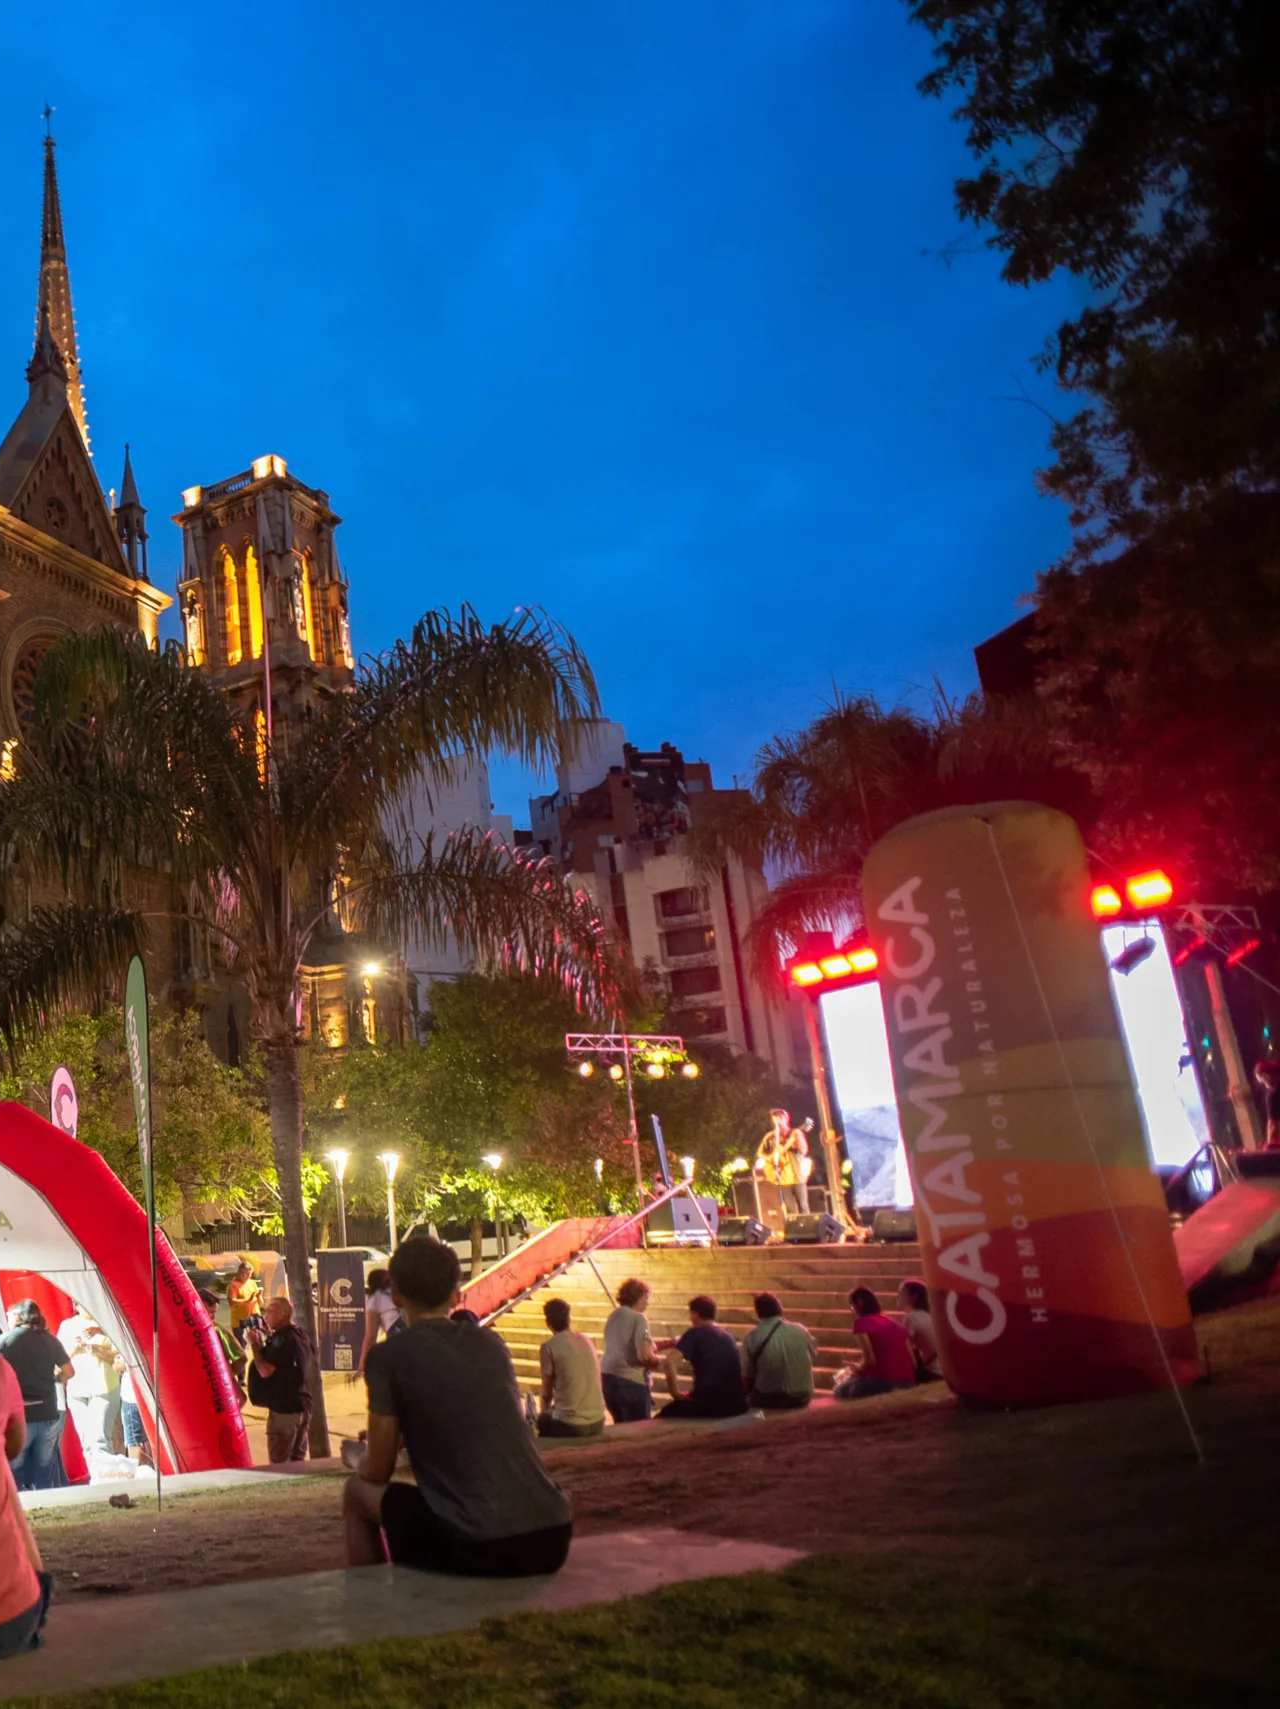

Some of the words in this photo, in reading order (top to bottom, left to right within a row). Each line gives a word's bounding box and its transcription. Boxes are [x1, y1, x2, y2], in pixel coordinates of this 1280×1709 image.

[946, 886, 997, 1074] NATURALEZA
[878, 876, 1007, 1345] CATAMARCA
[987, 1093, 1010, 1151] POR
[157, 1253, 184, 1306] Cultur
[1002, 1170, 1048, 1323] HERMOSA
[182, 1303, 196, 1328] de
[193, 1329, 225, 1414] Ministerio
